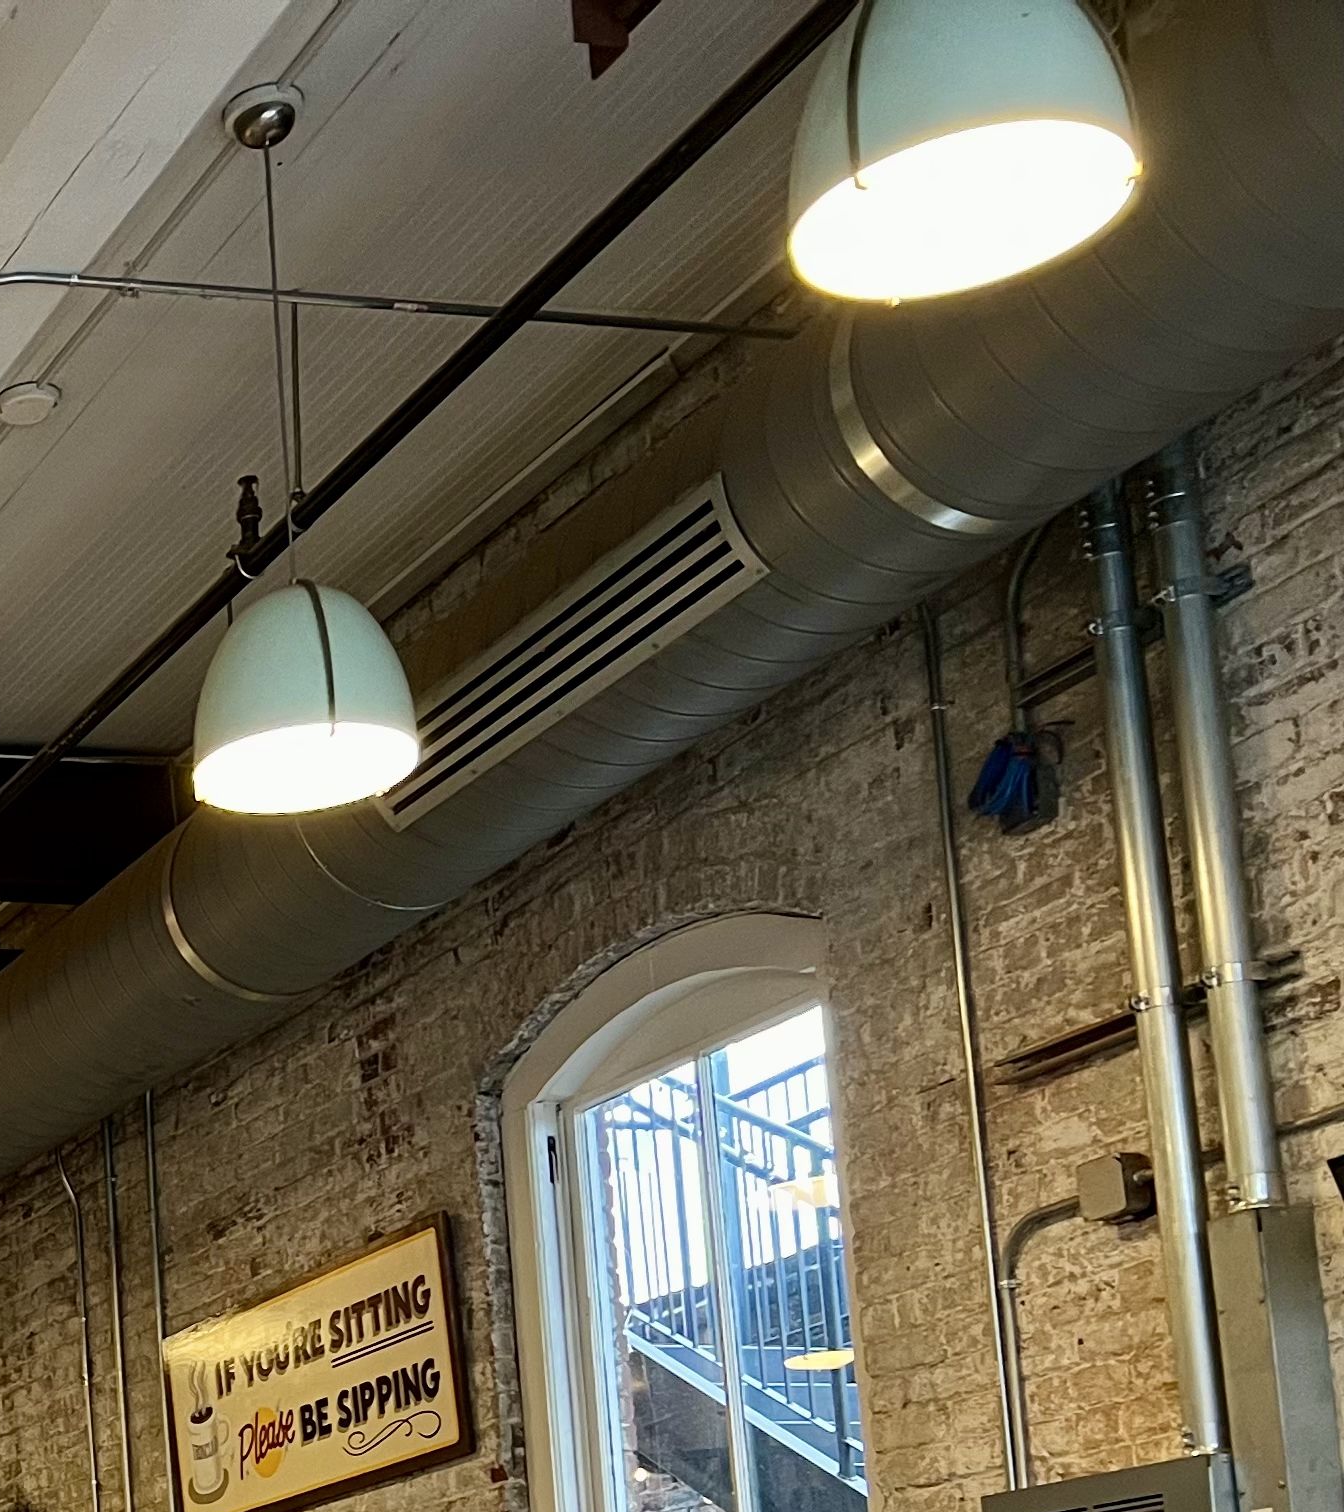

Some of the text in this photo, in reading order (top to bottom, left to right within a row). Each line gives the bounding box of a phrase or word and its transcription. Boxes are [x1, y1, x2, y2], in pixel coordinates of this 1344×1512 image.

[215, 1357, 236, 1399] IF
[329, 1274, 432, 1353] SITTING
[238, 1357, 442, 1480] Please BE SIPPING
